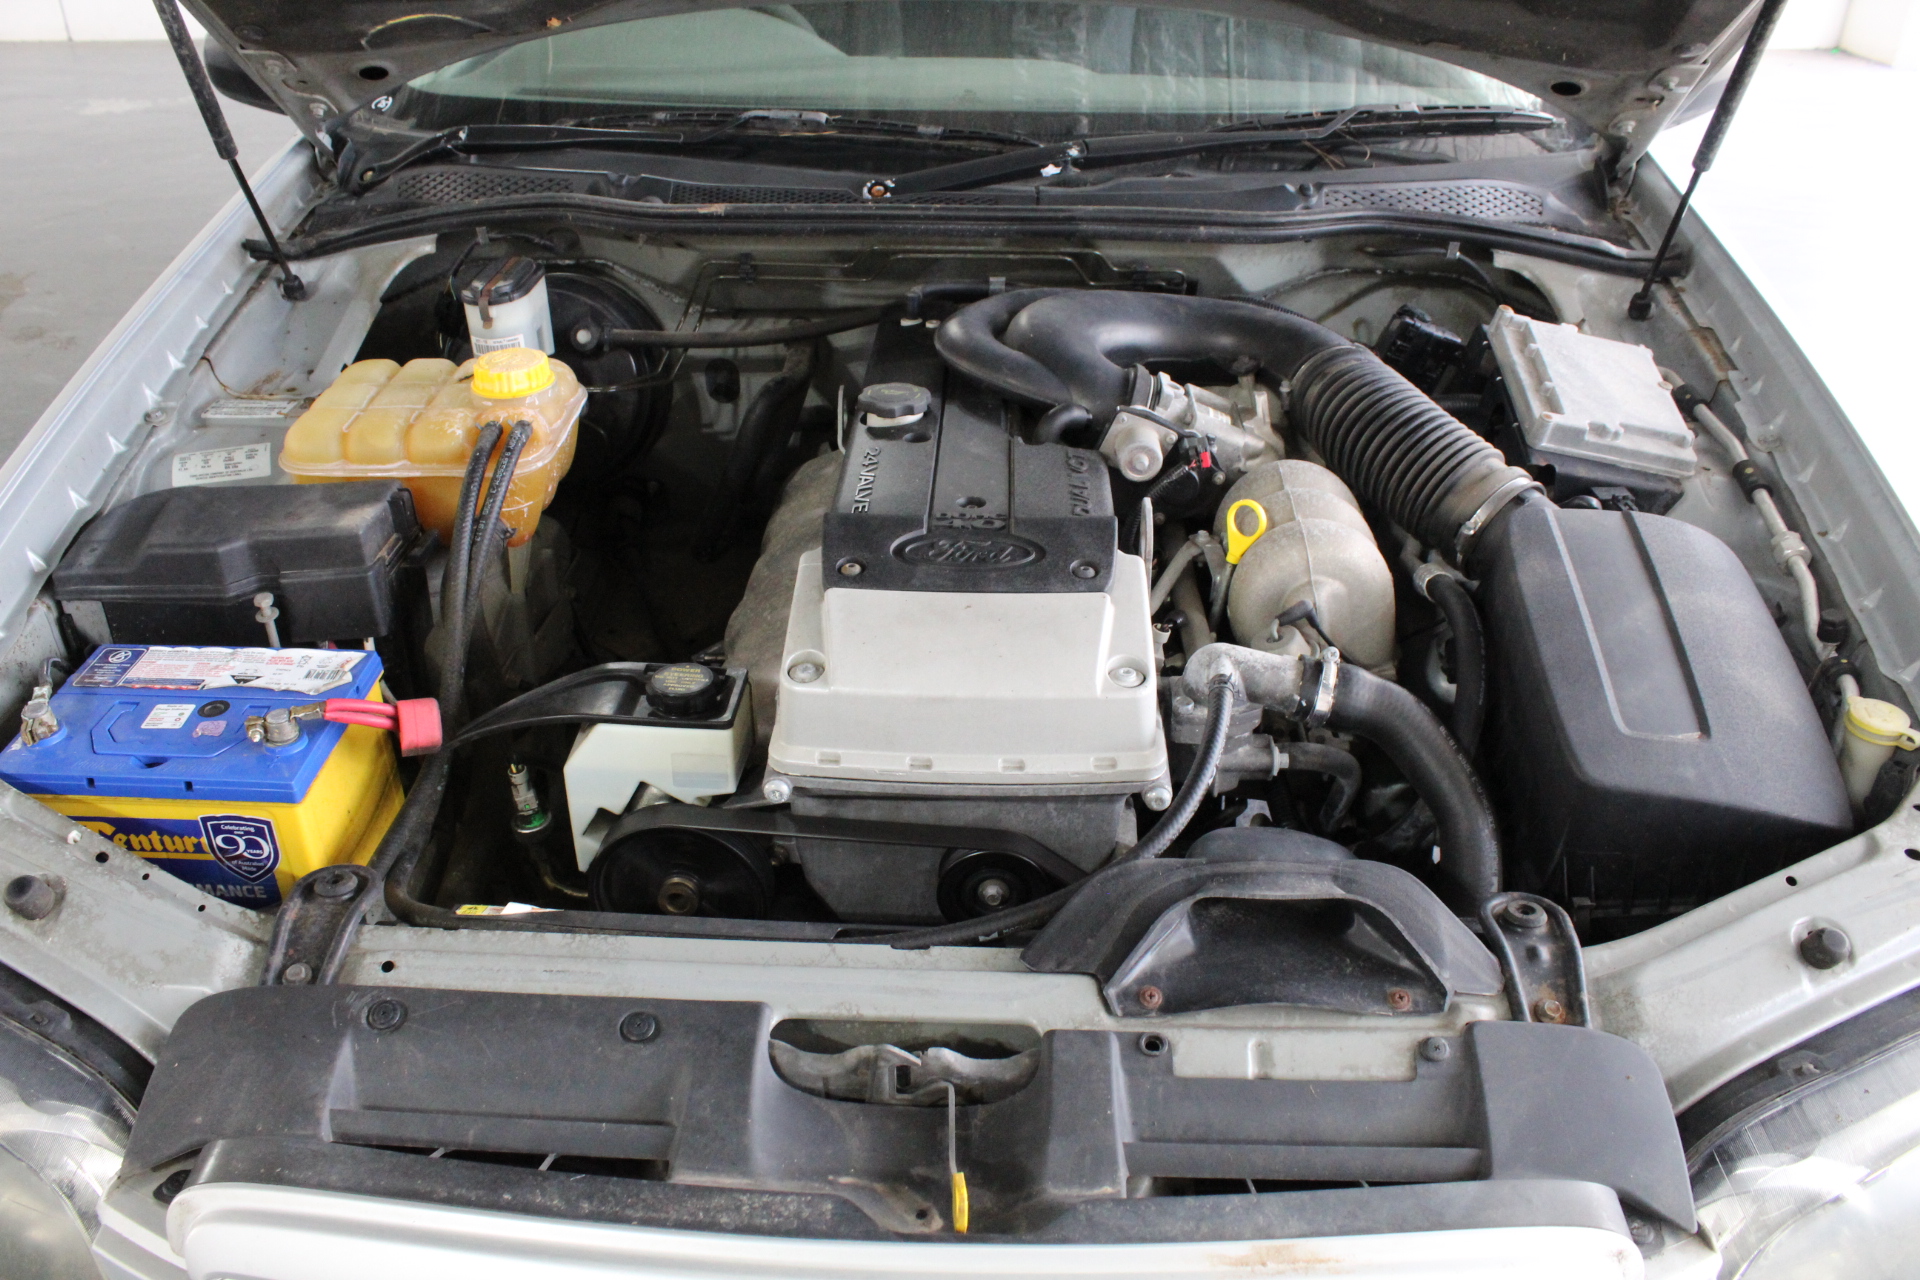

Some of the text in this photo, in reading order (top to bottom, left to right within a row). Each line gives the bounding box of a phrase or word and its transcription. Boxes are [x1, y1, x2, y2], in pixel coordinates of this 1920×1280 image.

[928, 540, 1014, 562] Ford
[220, 824, 255, 832] Celebrating
[215, 834, 270, 859] 90
